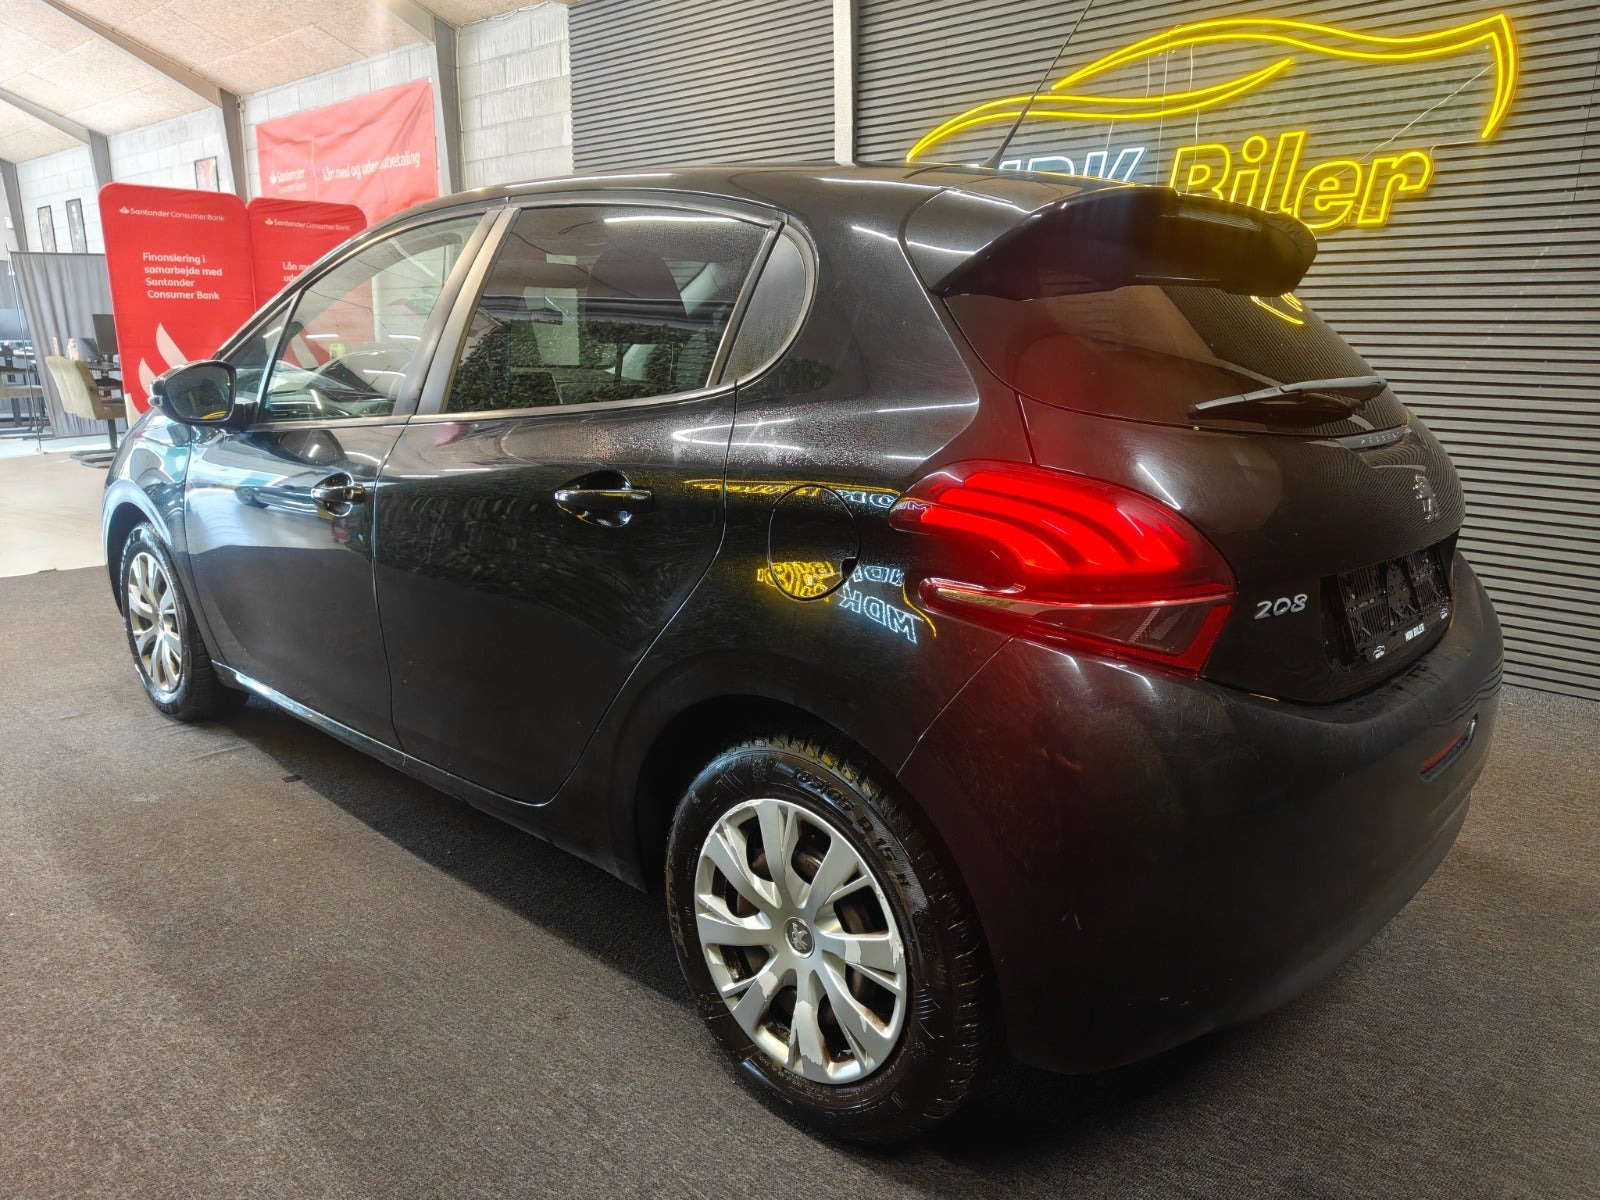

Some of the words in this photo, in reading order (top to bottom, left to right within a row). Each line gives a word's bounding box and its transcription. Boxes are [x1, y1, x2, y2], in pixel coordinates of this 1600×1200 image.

[1168, 130, 1432, 230] Biler
[130, 207, 170, 217] Santander
[170, 210, 206, 220] Consumer
[207, 213, 224, 222] Bank
[273, 219, 306, 229] Santander
[306, 221, 335, 230] Consumer
[142, 252, 201, 265] Finansiering
[202, 254, 206, 263] i
[282, 260, 298, 271] Lån
[144, 266, 201, 277] samarbejde
[201, 267, 223, 277] med
[145, 277, 195, 287] Santander
[147, 289, 195, 299] Consumer
[196, 290, 220, 300] Bank
[1254, 593, 1308, 620] 208
